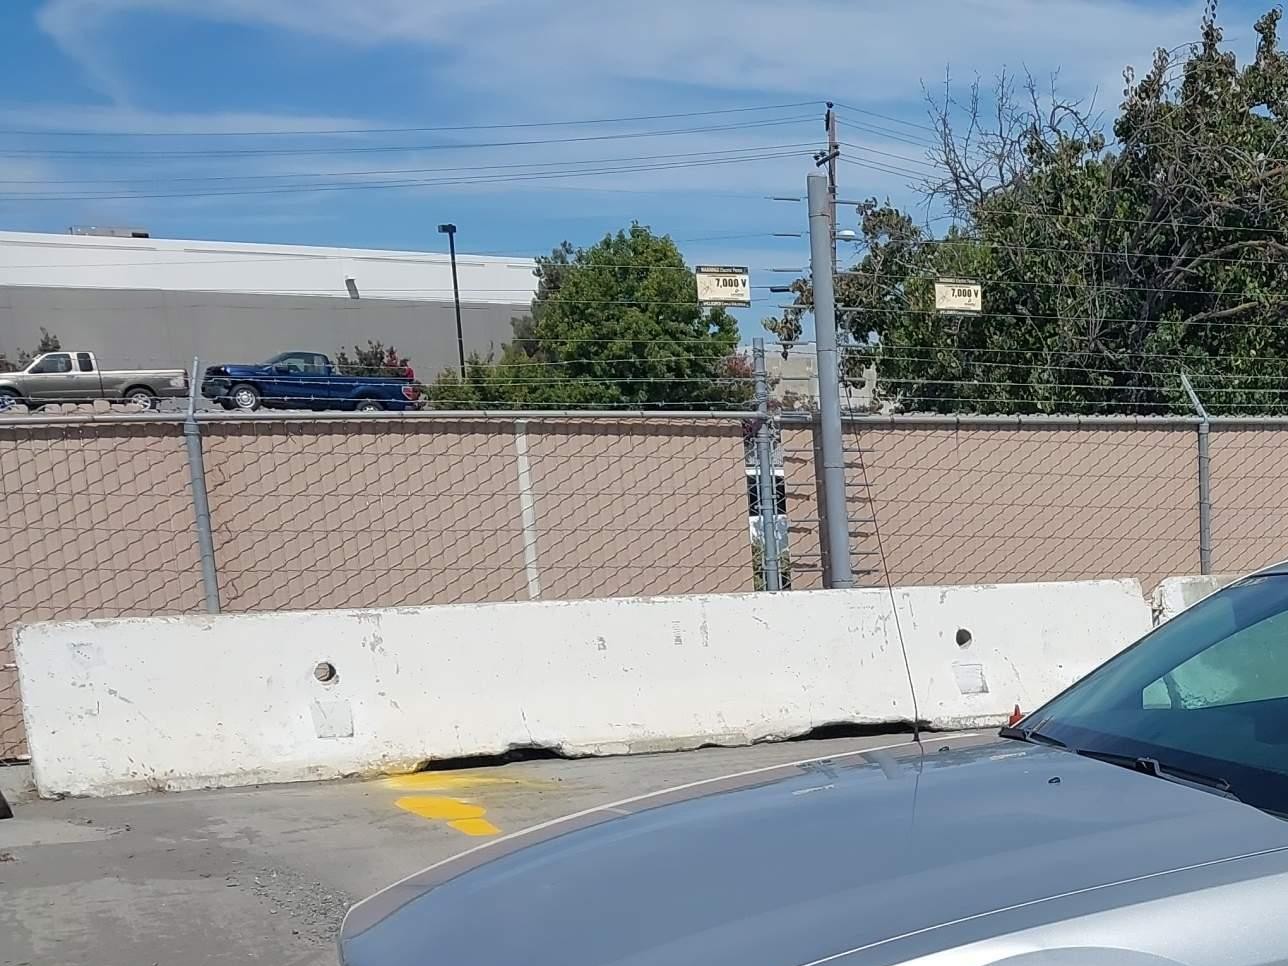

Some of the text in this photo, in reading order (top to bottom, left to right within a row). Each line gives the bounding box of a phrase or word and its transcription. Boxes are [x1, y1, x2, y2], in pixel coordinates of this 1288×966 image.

[715, 278, 747, 289] 7,000 V
[951, 288, 979, 298] 7,000 V
